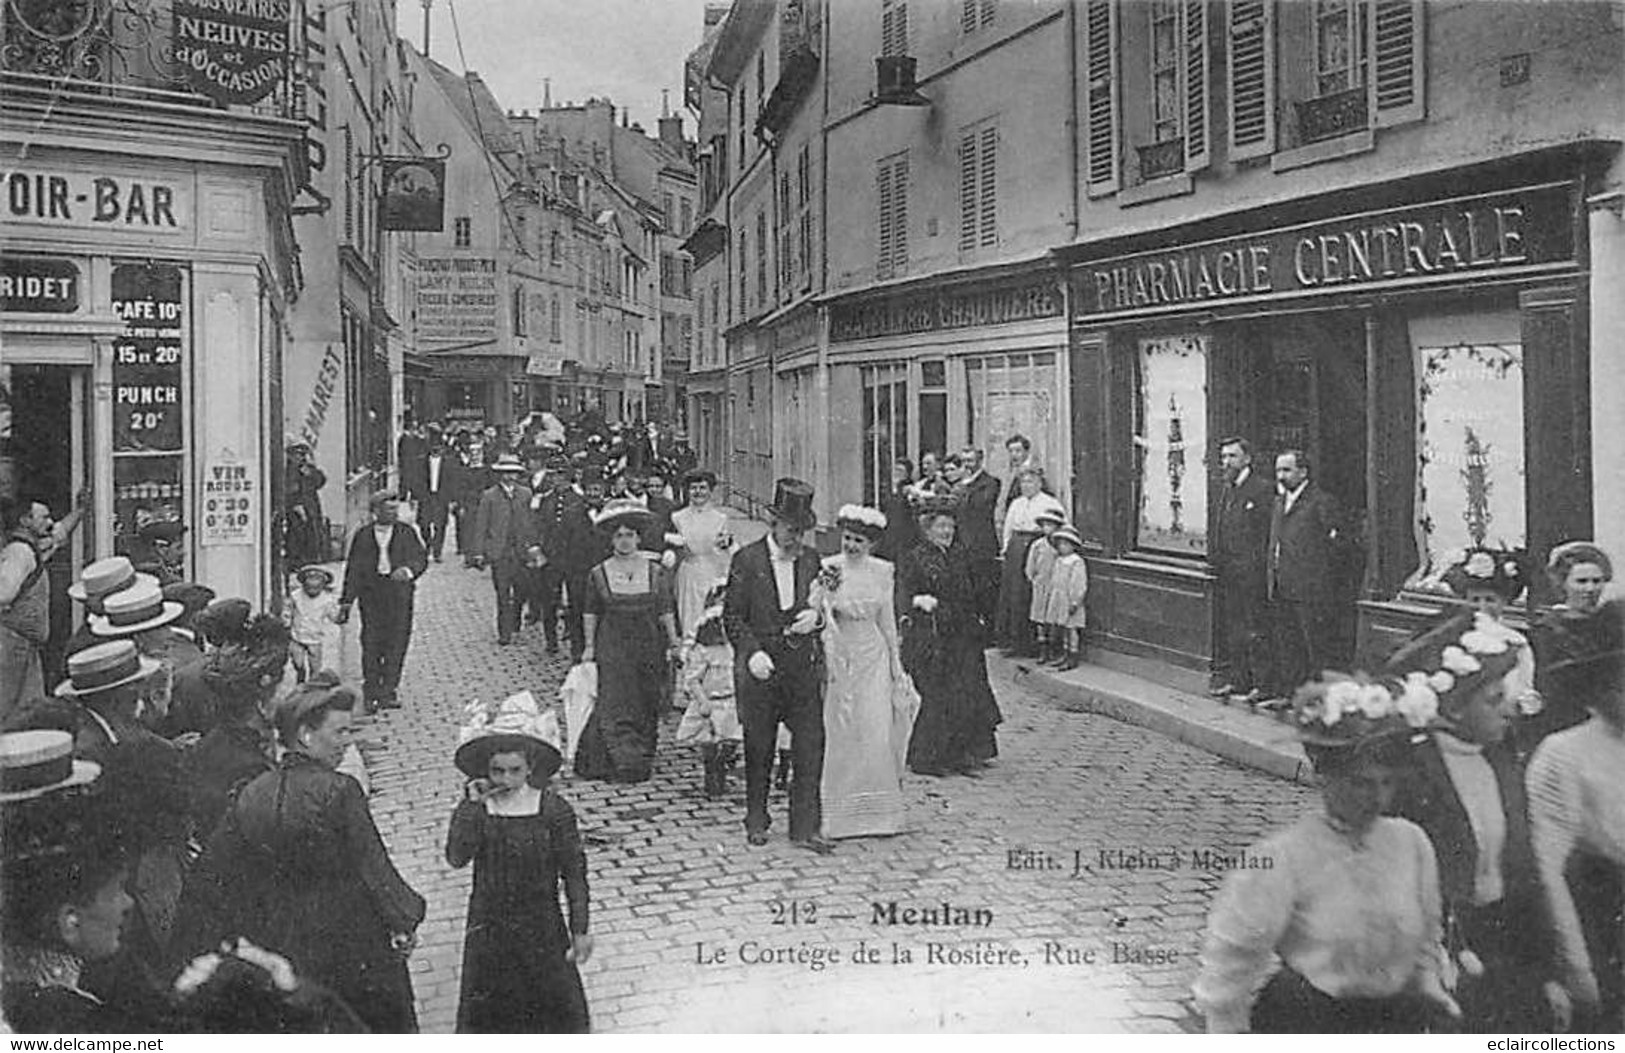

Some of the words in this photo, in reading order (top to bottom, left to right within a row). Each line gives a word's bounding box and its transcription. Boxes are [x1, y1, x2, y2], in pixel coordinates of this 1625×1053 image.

[177, 15, 286, 52] NEUVES
[222, 52, 244, 65] et
[292, 0, 331, 216] VOLAIL
[1095, 246, 1272, 308] PHARMACIE
[1295, 207, 1528, 285] CENTRALE
[118, 346, 137, 363] 15
[117, 386, 177, 403] PUNCH
[300, 344, 342, 449] EMAREST
[212, 466, 246, 480] VIN
